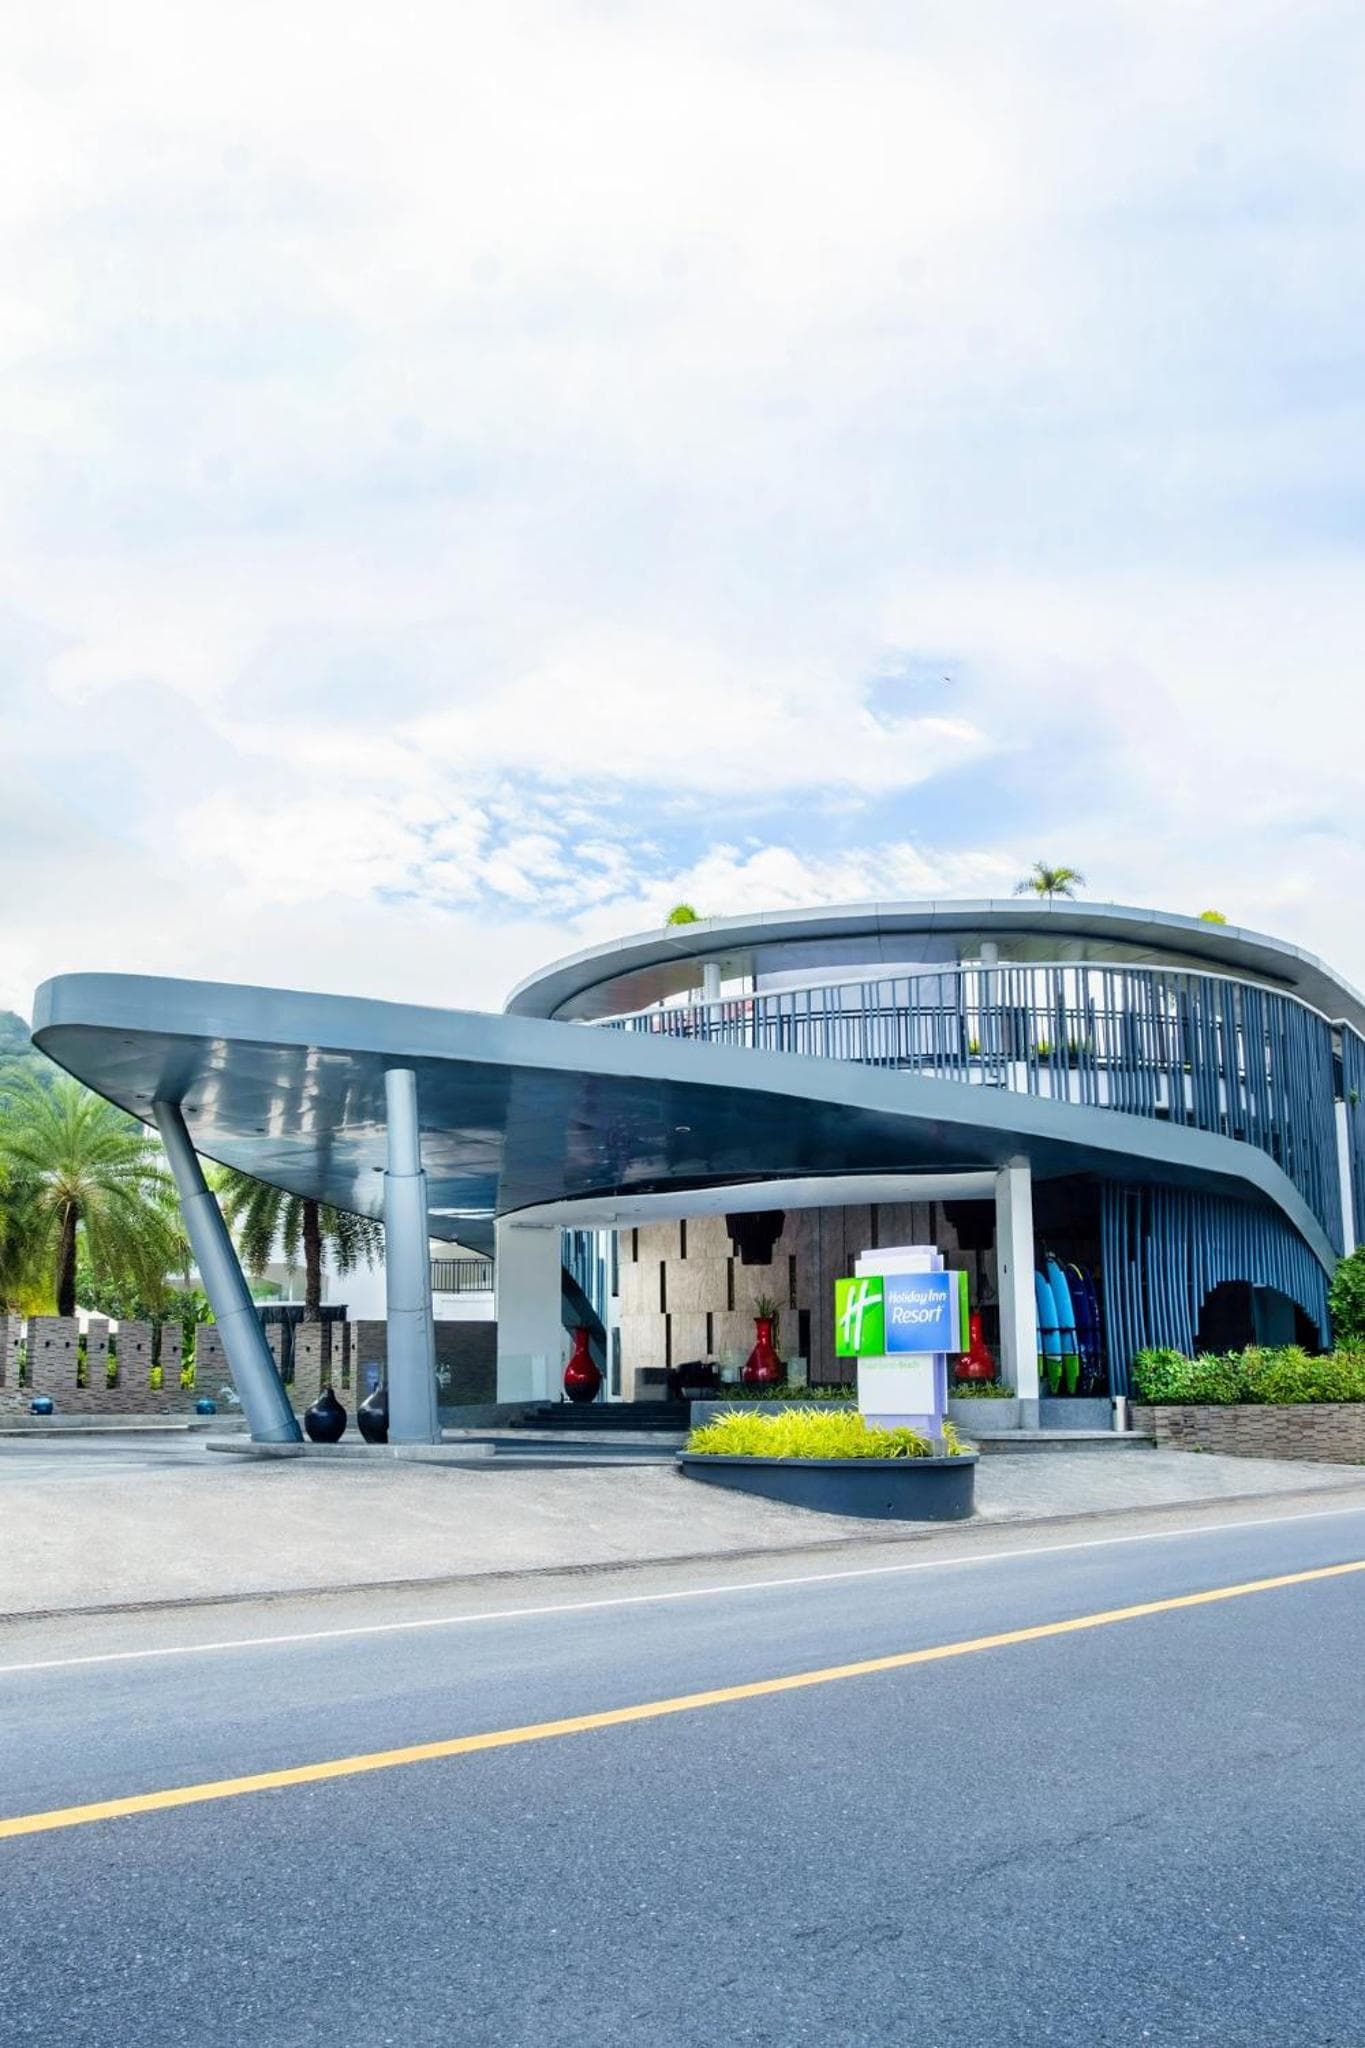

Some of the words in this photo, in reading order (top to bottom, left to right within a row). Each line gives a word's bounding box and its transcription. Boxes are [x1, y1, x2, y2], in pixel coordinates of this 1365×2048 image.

[889, 1290, 928, 1305] Holiday
[929, 1289, 947, 1302] Inn
[892, 1305, 943, 1323] Resort
